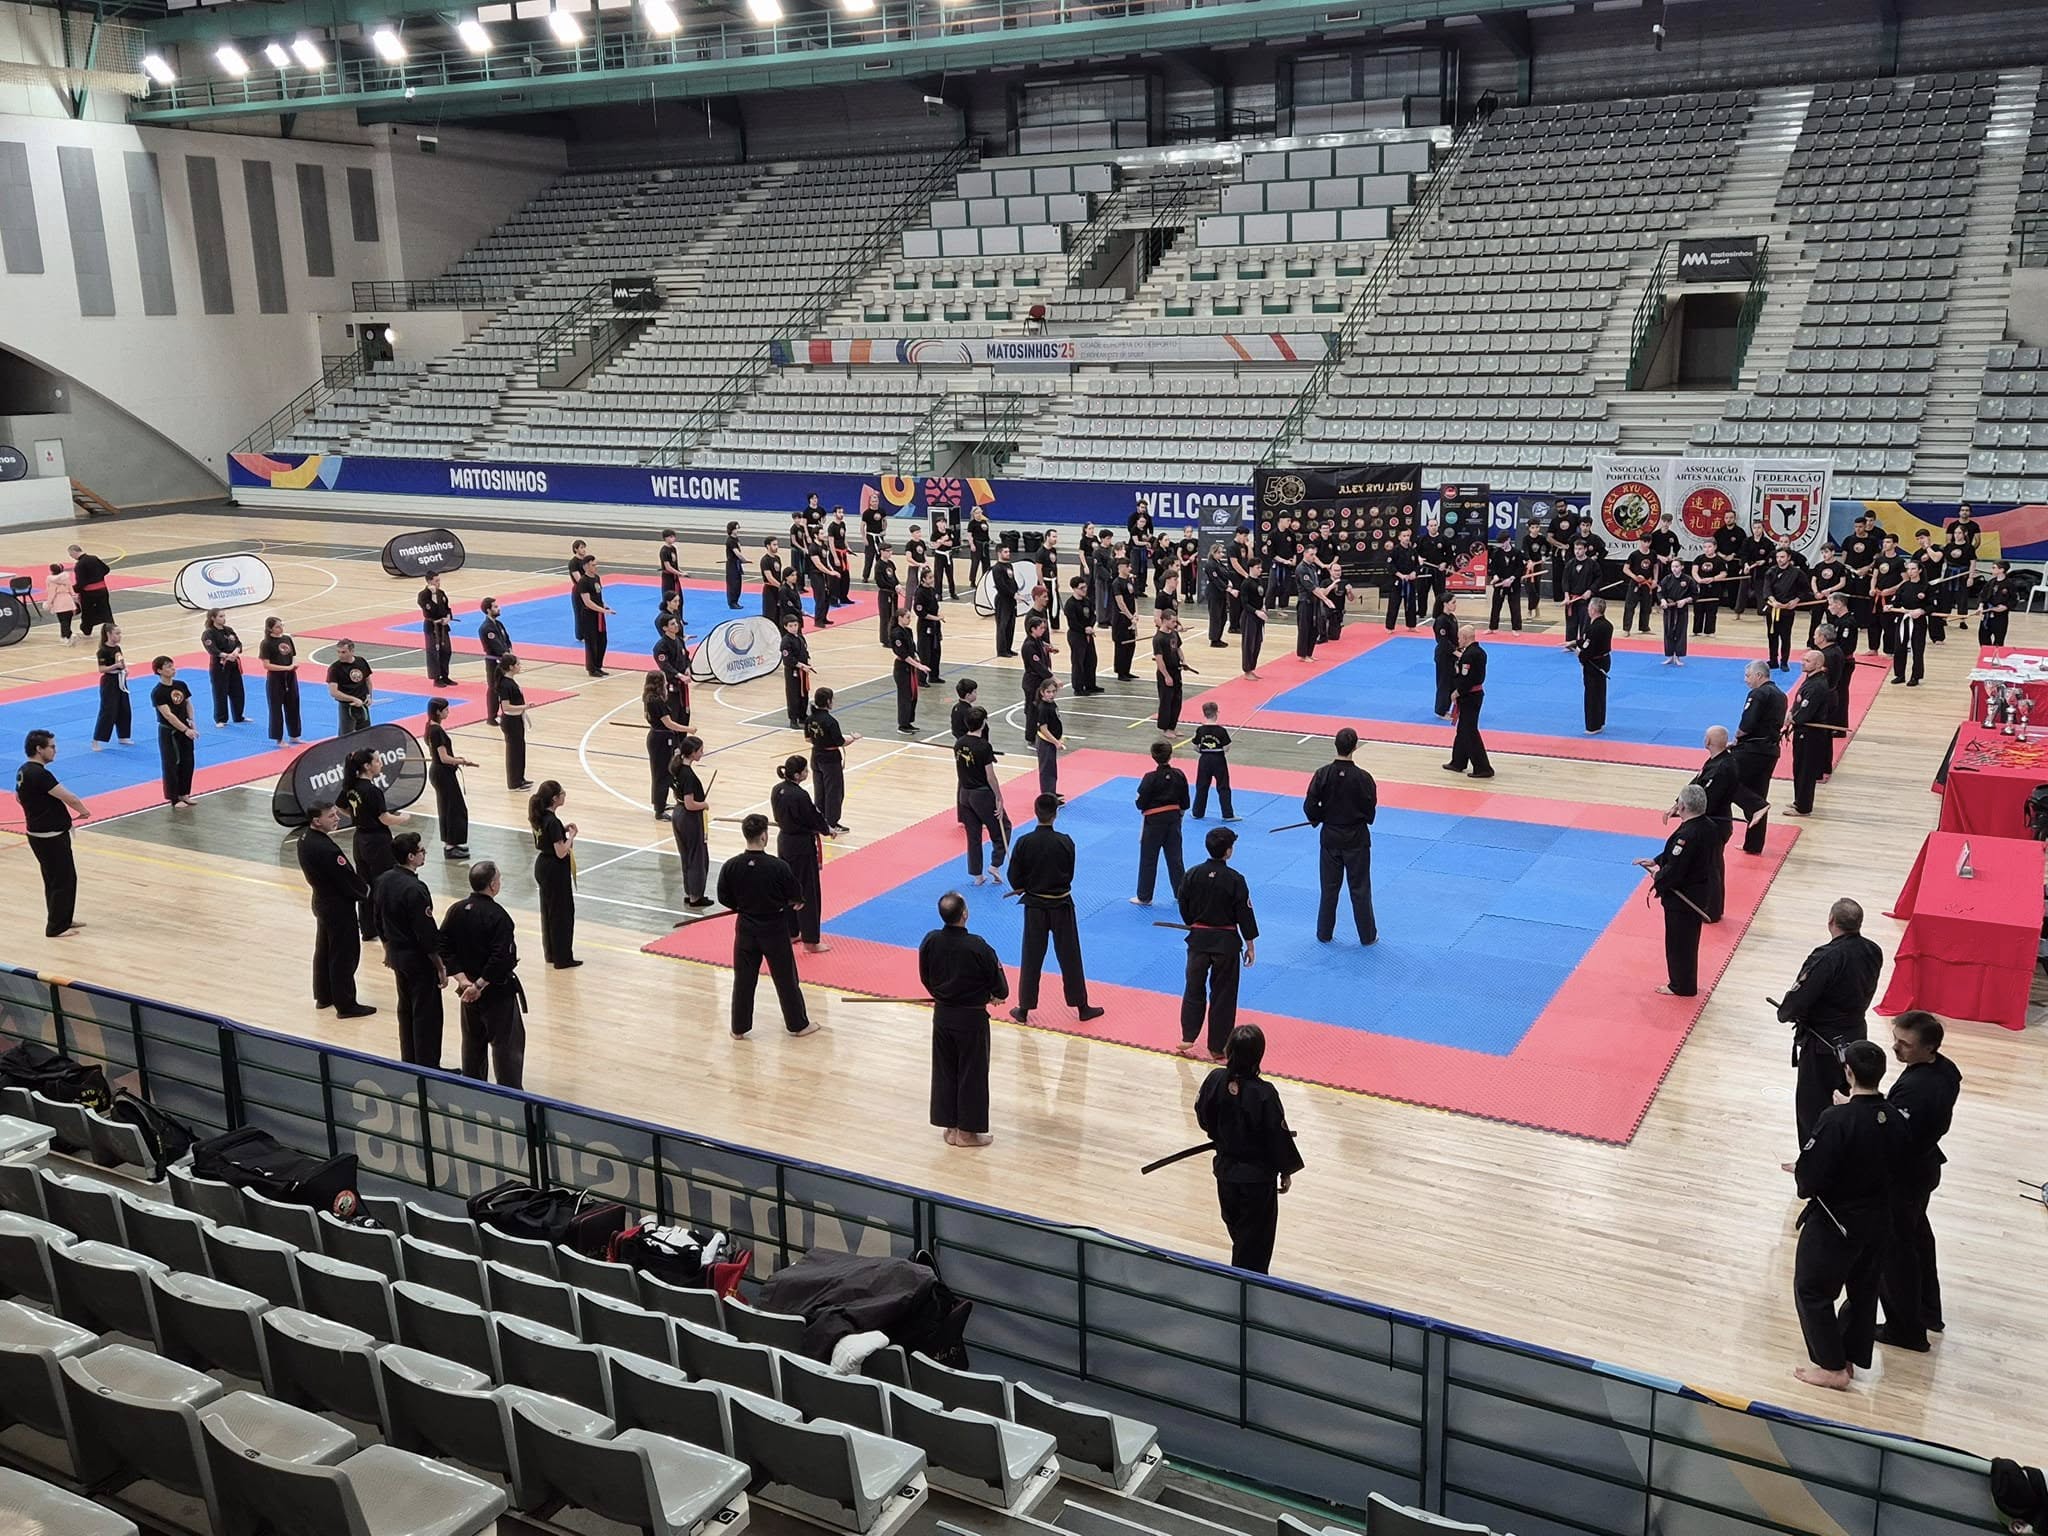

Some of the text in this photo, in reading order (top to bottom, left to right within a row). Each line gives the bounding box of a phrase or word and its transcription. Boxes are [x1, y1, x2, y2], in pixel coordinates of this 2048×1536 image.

[1608, 465, 1660, 474] ASSOCIAÇÃO
[1684, 465, 1739, 475] ASSOCIAÇÃO
[449, 467, 548, 493] MATOSINHOS
[1757, 473, 1821, 483] FEDERAÇÃO
[651, 475, 741, 501] WELCOME
[1339, 481, 1414, 495] ALEX RYU JITSU
[1623, 484, 1641, 494] RYU
[399, 541, 454, 557] matosinhos
[417, 552, 443, 565] sport
[1358, 595, 1363, 606] 1
